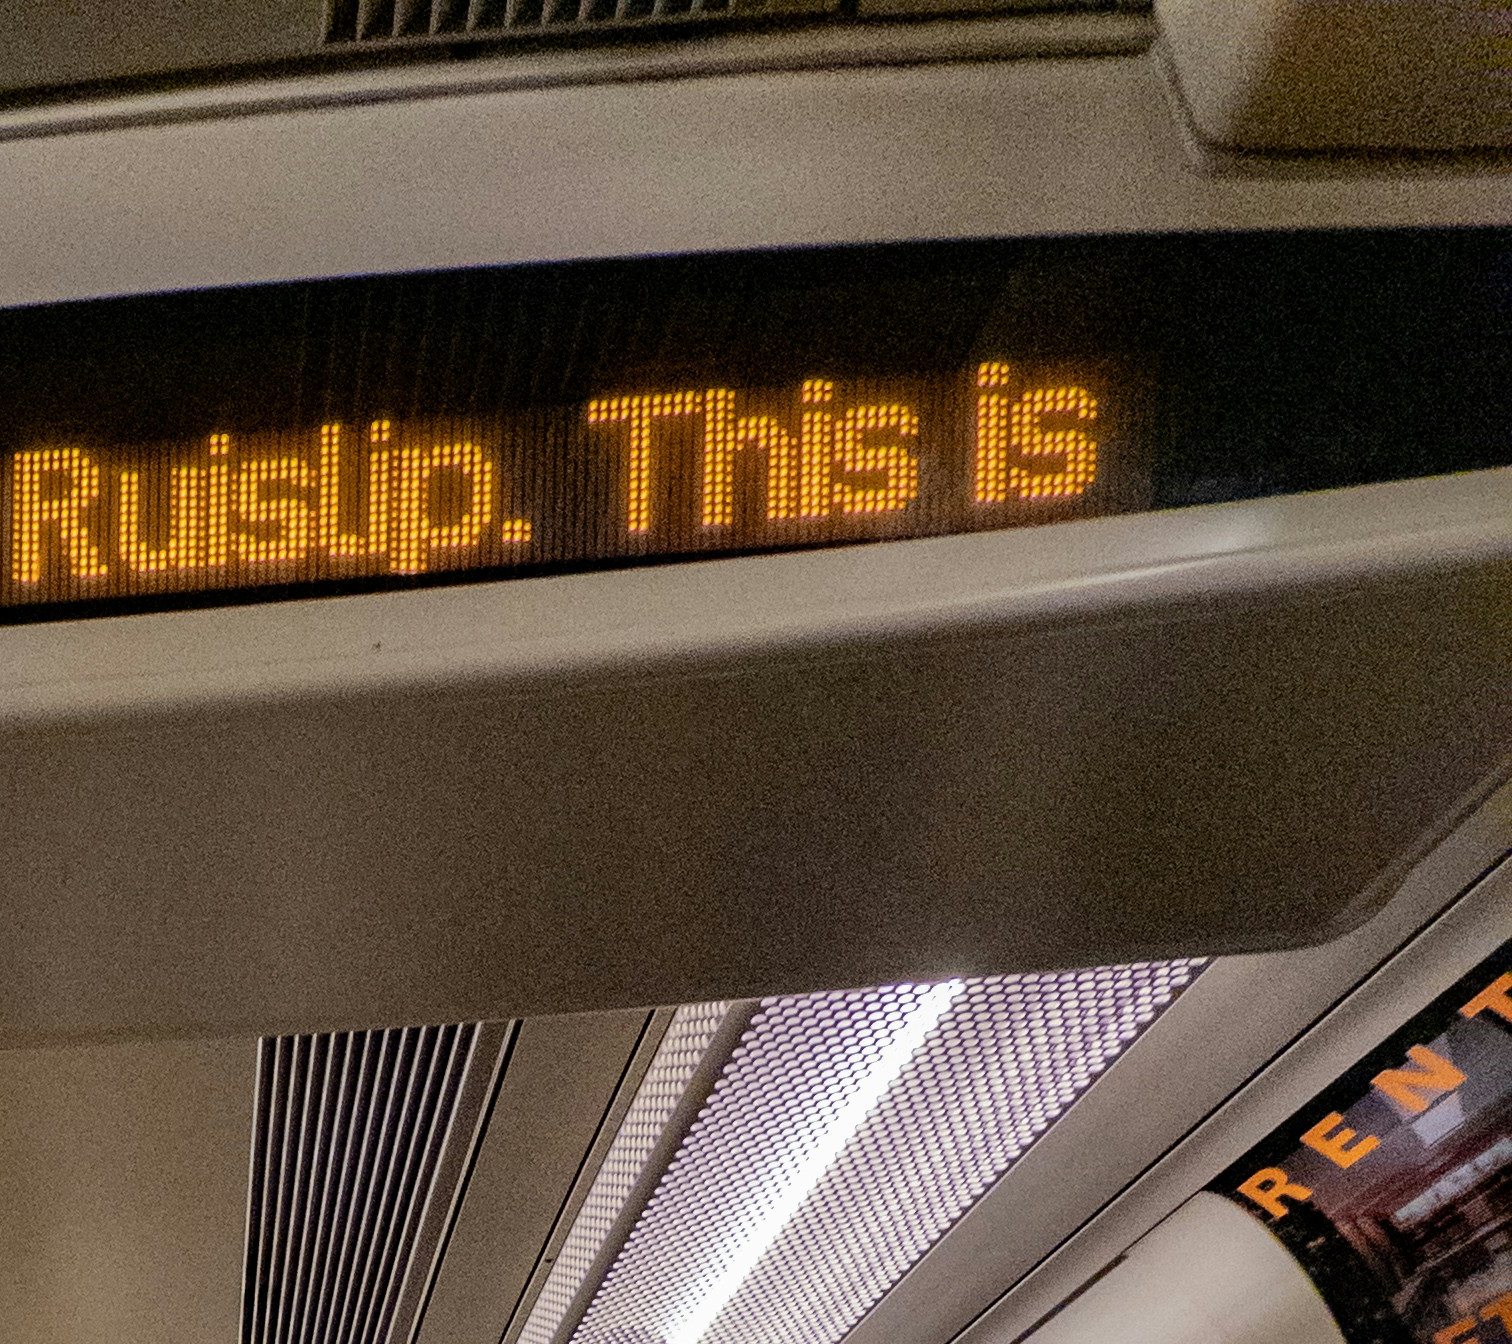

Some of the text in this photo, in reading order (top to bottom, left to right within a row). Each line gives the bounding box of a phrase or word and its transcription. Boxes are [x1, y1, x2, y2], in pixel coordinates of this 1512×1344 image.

[13, 419, 532, 585] Ruislip.
[589, 378, 918, 533] This
[975, 361, 1099, 505] is
[1238, 971, 1512, 1220] RENT
